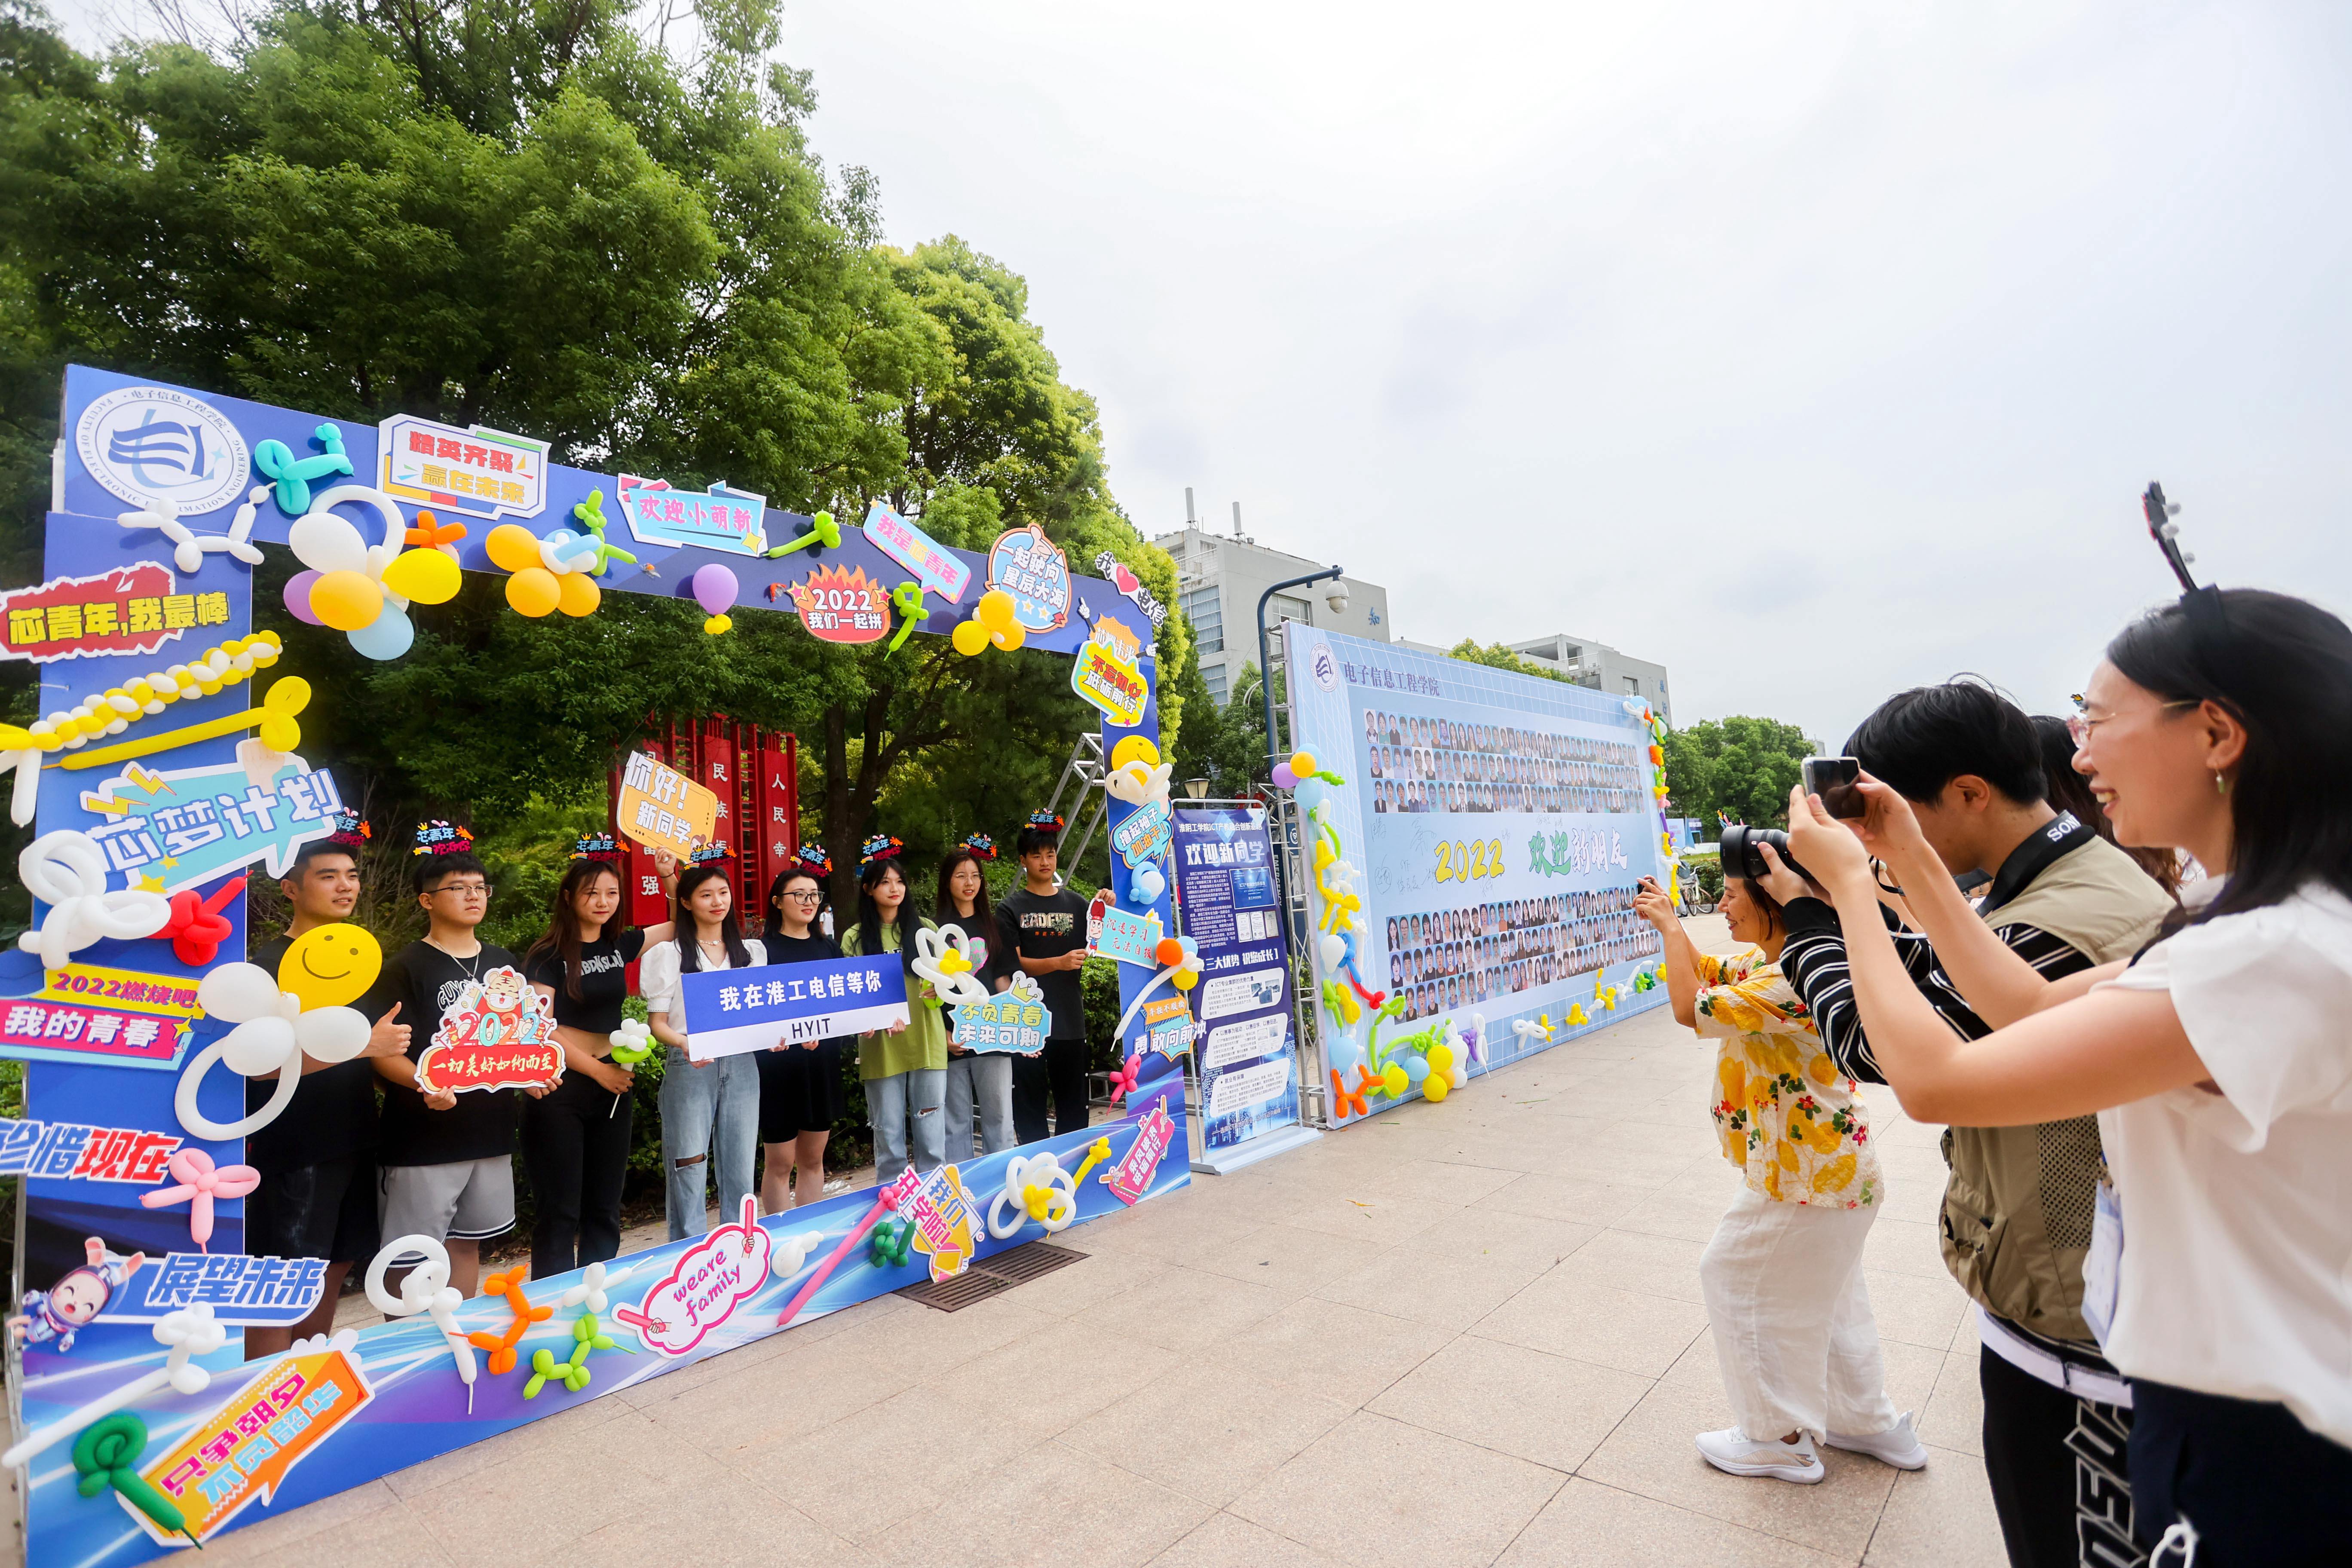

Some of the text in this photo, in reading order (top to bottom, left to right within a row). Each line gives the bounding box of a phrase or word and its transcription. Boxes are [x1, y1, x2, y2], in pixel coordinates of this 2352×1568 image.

[131, 389, 227, 429] 电子信息工程学院
[81, 398, 245, 512] FACULTY OF ELECTRONIC IRMATION ENGINEERING
[409, 431, 514, 474] 精英齐聚
[422, 463, 526, 504] 赢在未来
[639, 496, 753, 533] 欢迎小萌新
[876, 513, 960, 586] 我是芯青年
[998, 542, 1060, 584] 一起驶向
[814, 587, 873, 612] 2022
[1002, 565, 1066, 610] 星辰大海
[1096, 552, 1167, 627] 我 电信
[808, 611, 882, 631] 我们一起拼
[1084, 669, 1137, 714] 砥砺前行
[1092, 655, 1142, 698] 不忘初心
[1344, 661, 1440, 696] 电子信息工程学院
[86, 769, 345, 874] 芯梦计划
[334, 815, 358, 832] 青年
[417, 827, 455, 843] 芯青年
[636, 800, 692, 845] 新同学
[1030, 813, 1054, 824] 芯青年
[1118, 806, 1158, 847] 撸起袖子
[2047, 815, 2082, 842] SON
[577, 839, 615, 851] 芯青年
[691, 848, 724, 861] 芯青年
[799, 845, 825, 864] 芯青年
[862, 839, 890, 855] 芯青年
[966, 835, 991, 850] 芯青年
[1185, 841, 1265, 865] 欢迎新同学
[1434, 838, 1504, 883] 2022
[1528, 827, 1628, 878] 欢迎新朋友
[1106, 917, 1148, 941] 沉迷学习
[720, 969, 882, 1013] 我在淮工电信等你
[1149, 1000, 1185, 1017] 年轻不服输
[4, 1005, 161, 1048] 我的青春
[459, 1011, 541, 1047] 2022
[791, 1018, 830, 1039] HYIT
[961, 1002, 1043, 1026] 不负青春
[959, 1023, 1041, 1047] 未来可期
[1134, 1019, 1207, 1055] 勇敢向前冲
[432, 1053, 555, 1078] 一切美好如约而至
[0, 1120, 184, 1184] 珍惜现在
[1128, 1124, 1158, 1174] 乘风破浪
[1133, 1136, 1161, 1186] 砥砺前行
[928, 1176, 967, 1228] 我们
[144, 1252, 331, 1308] 展望未来
[686, 1263, 740, 1326] family
[160, 1373, 306, 1497] 只争朝夕
[196, 1380, 343, 1504] 不负韶华
